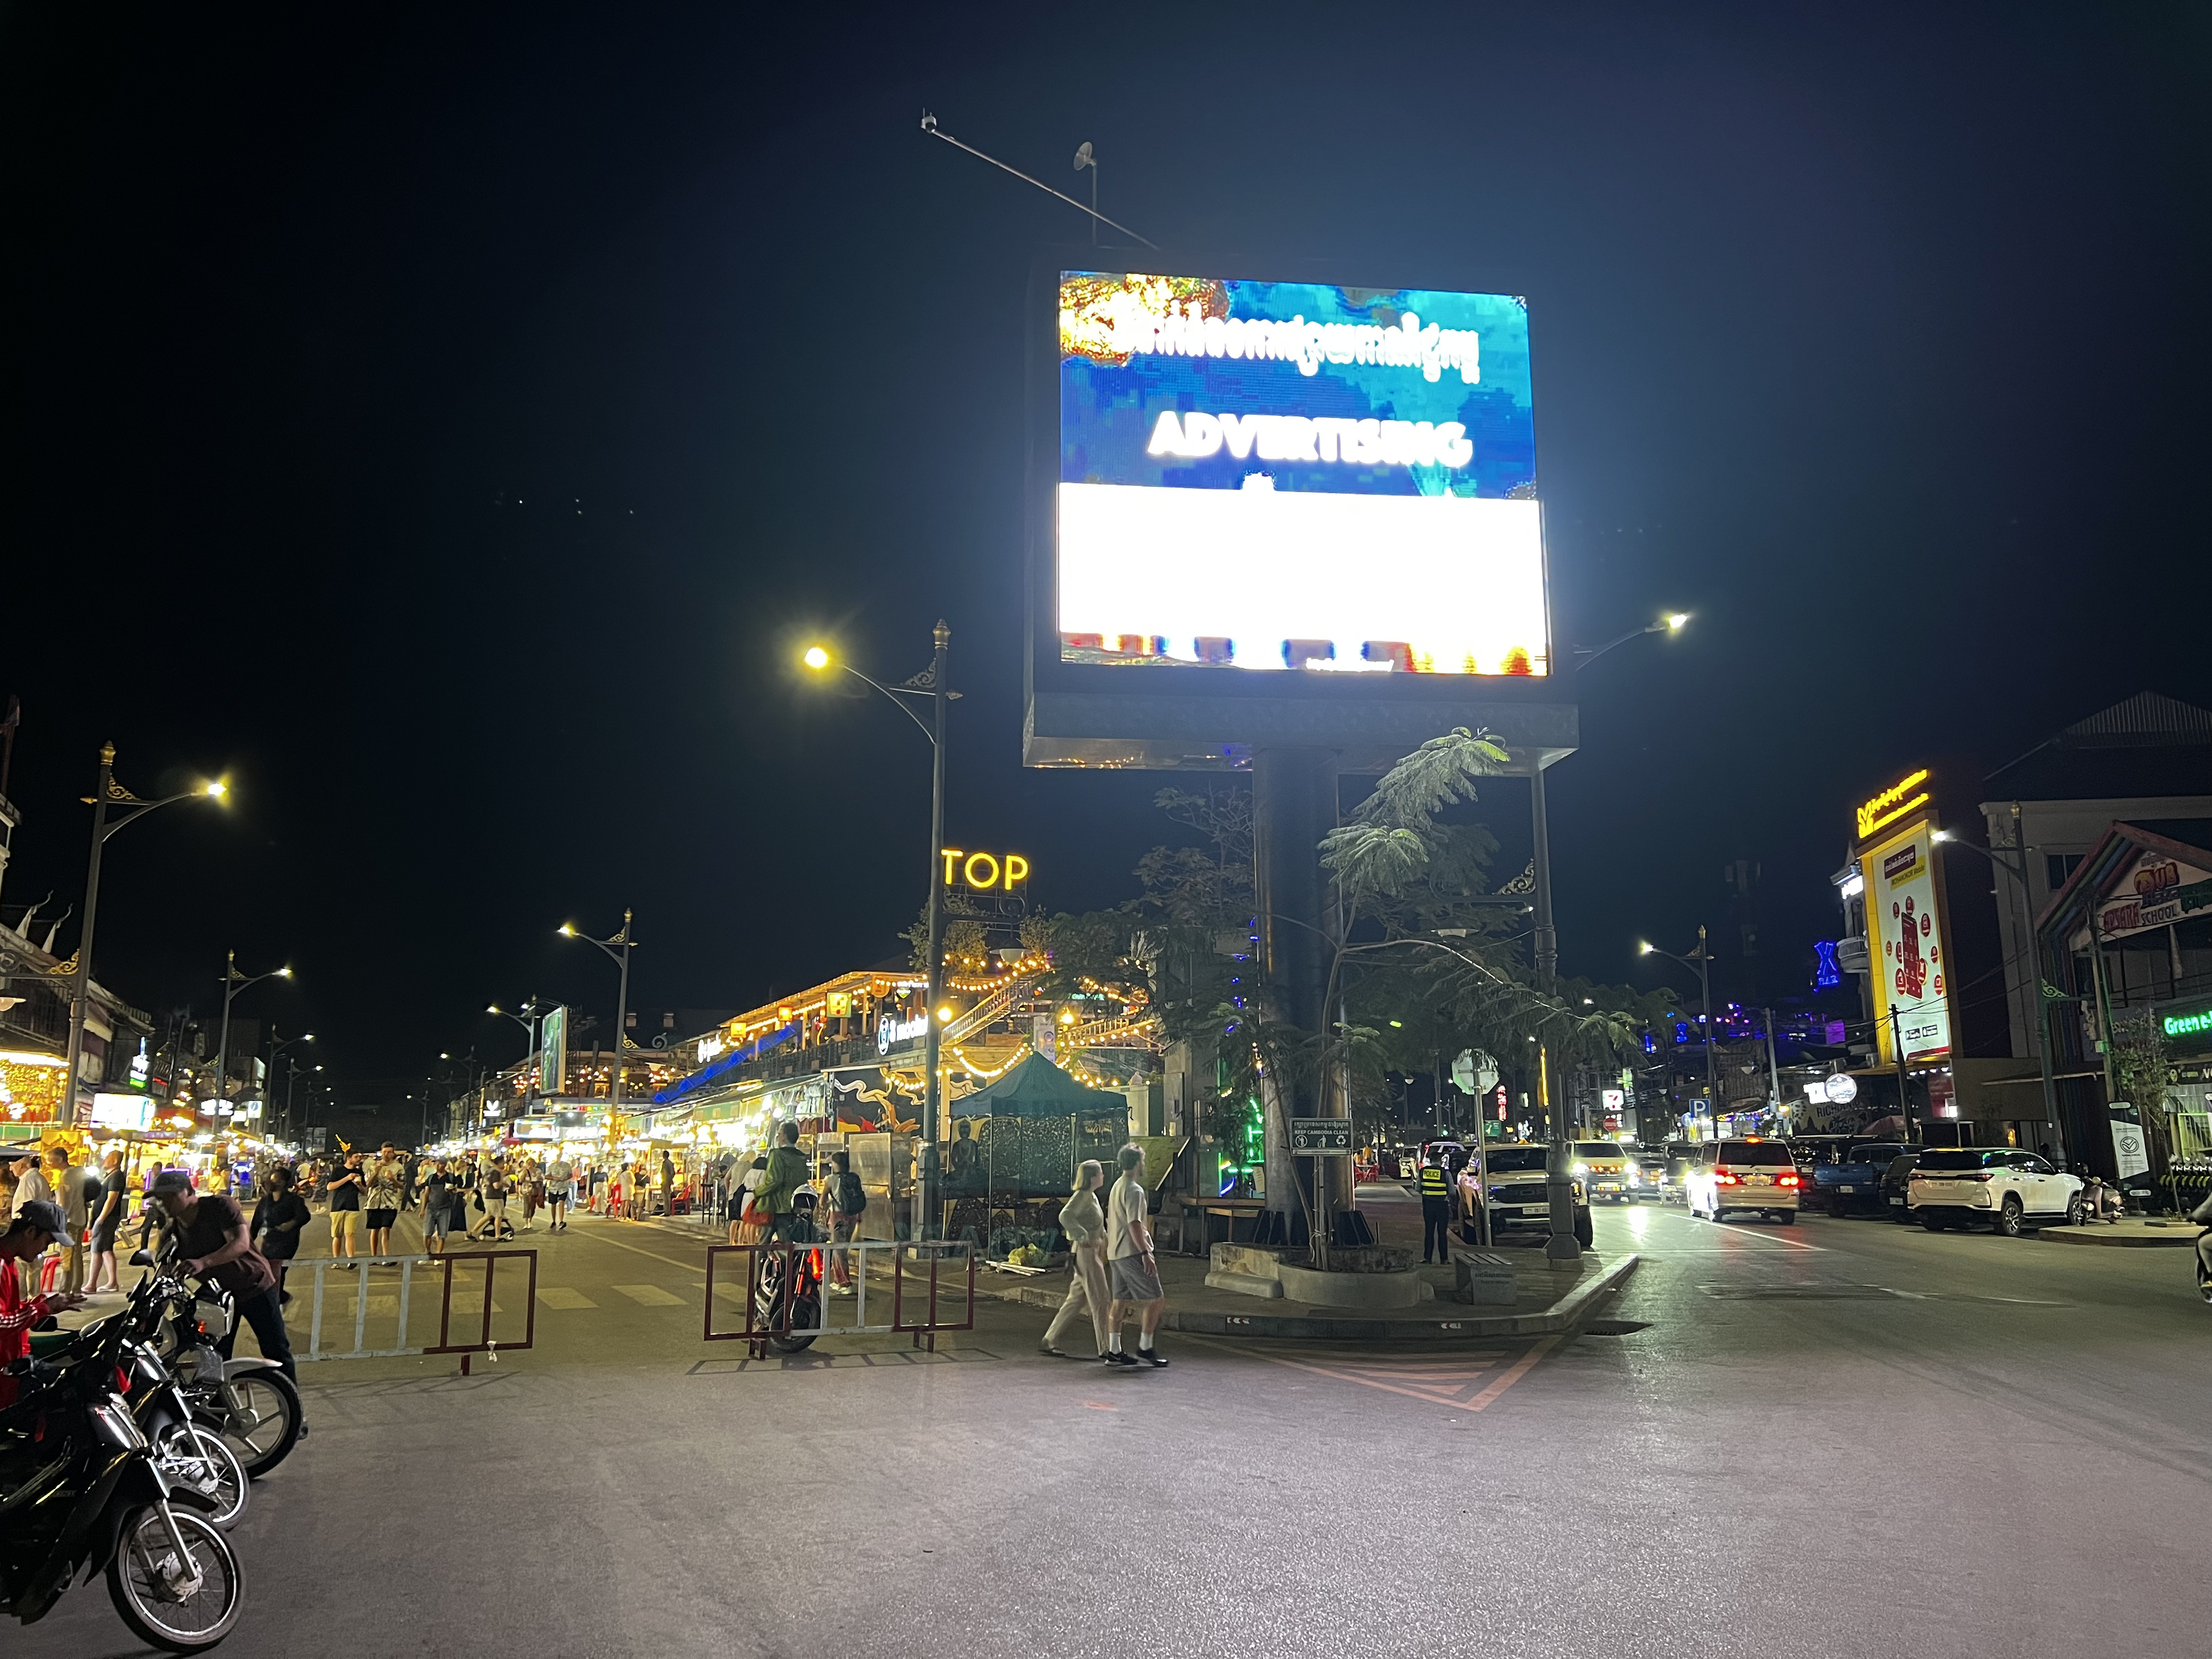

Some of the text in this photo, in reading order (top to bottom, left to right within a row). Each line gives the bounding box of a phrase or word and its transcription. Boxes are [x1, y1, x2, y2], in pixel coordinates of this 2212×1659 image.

[1148, 411, 1473, 468] ADVERTISING
[941, 848, 1029, 890] TOP
[2141, 904, 2178, 926] SCHOOL
[2164, 1016, 2200, 1035] Green
[1694, 1100, 1706, 1117] P
